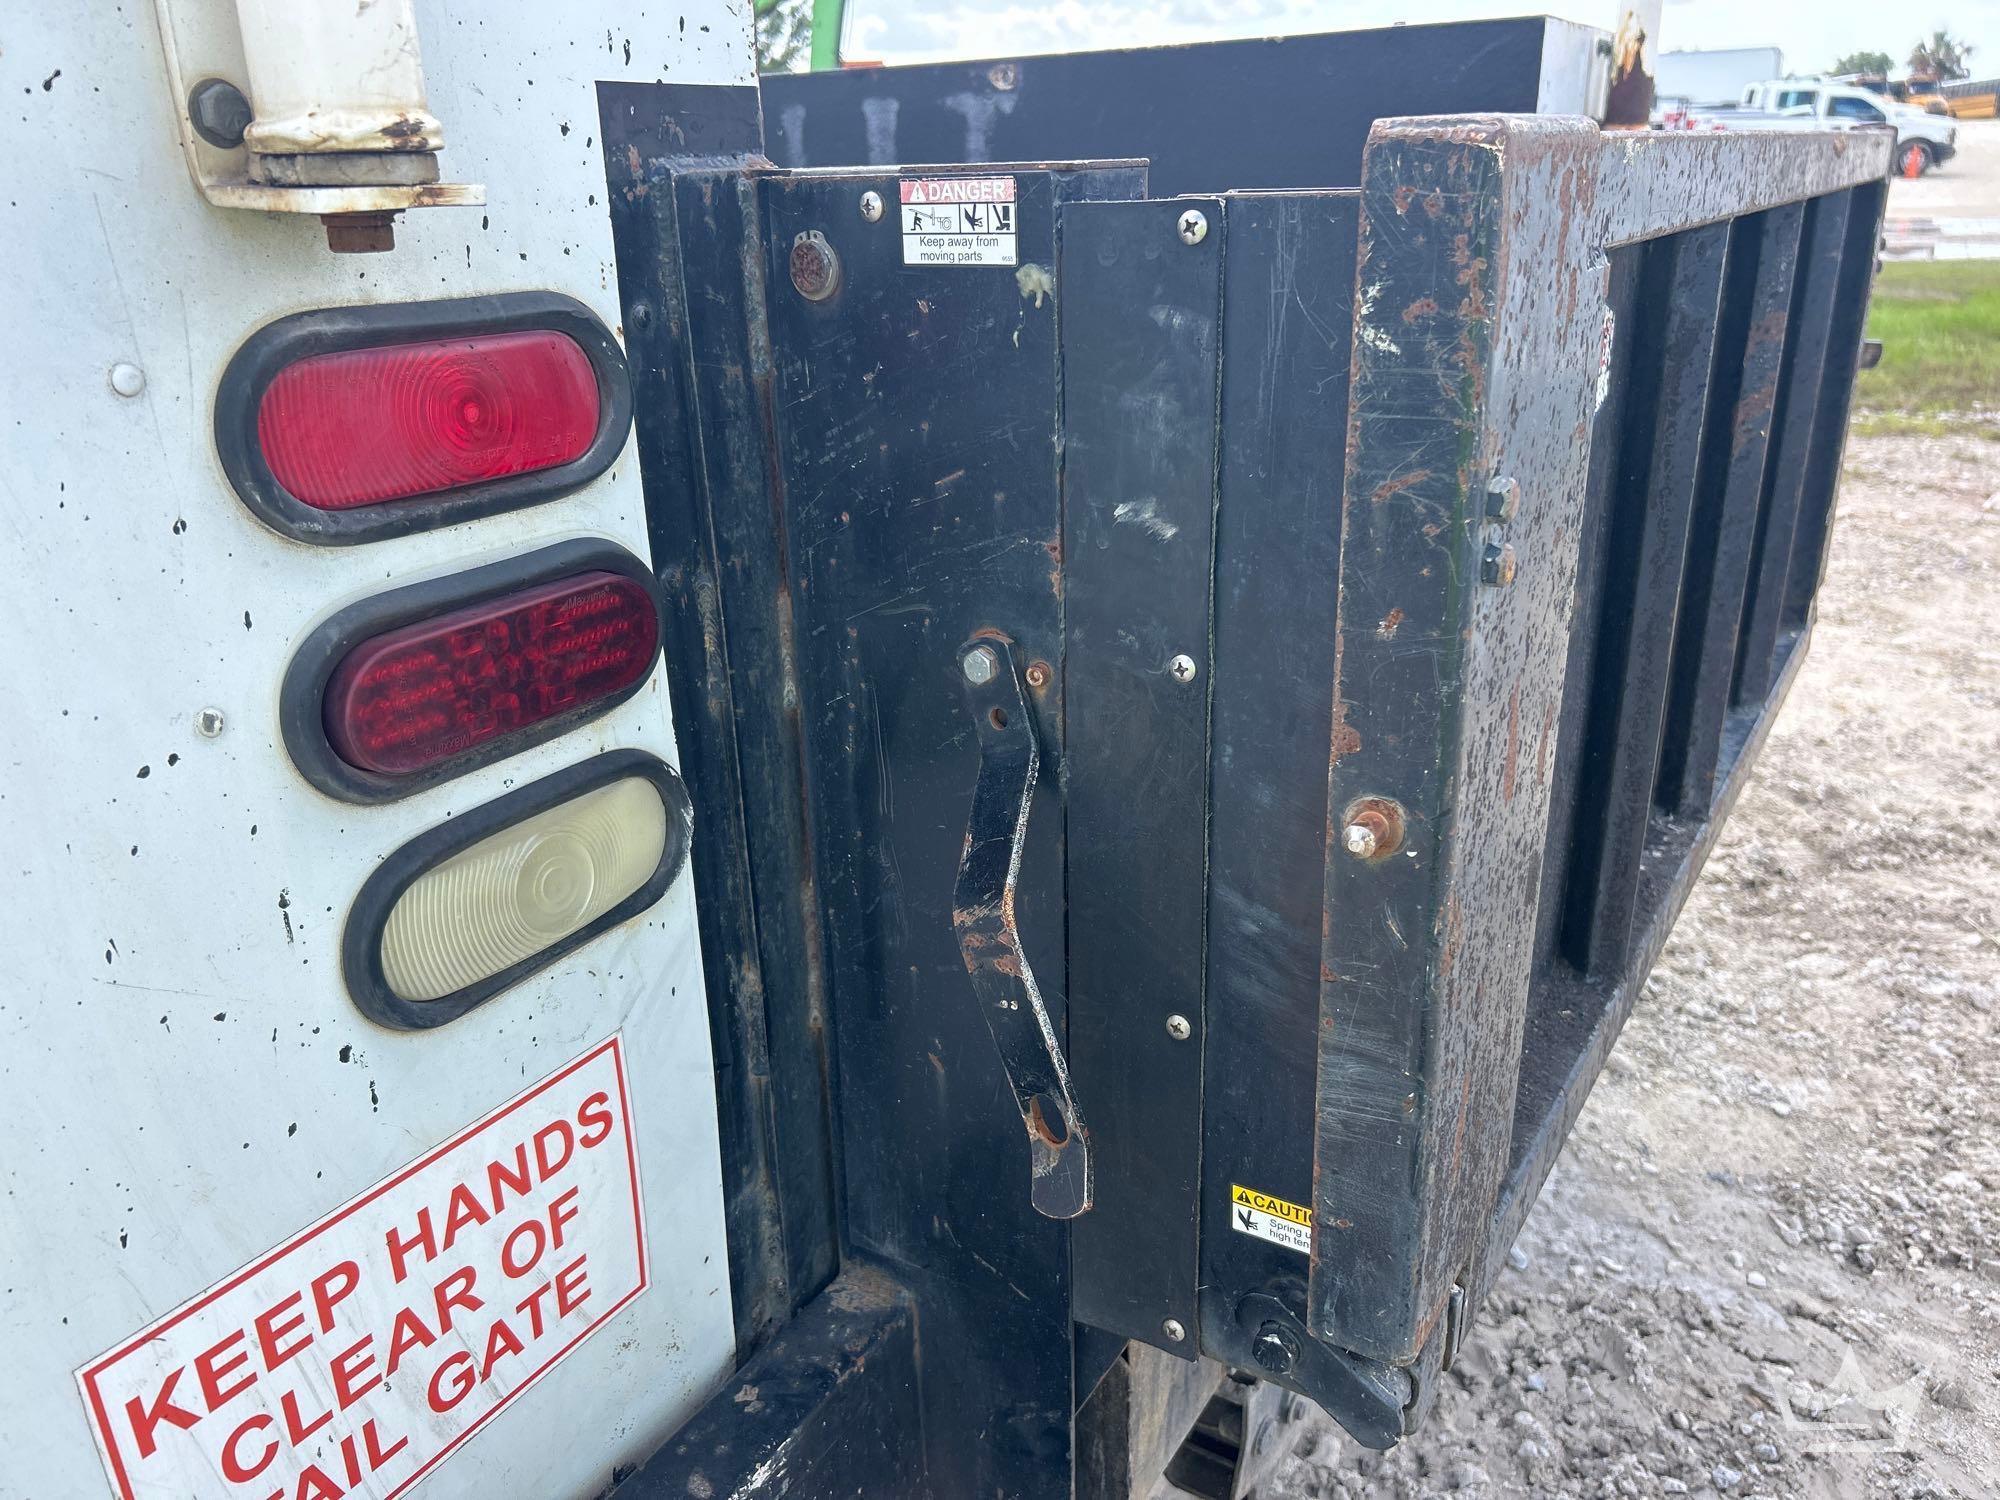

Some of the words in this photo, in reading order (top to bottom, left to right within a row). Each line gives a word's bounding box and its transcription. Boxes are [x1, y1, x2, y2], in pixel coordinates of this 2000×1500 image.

[928, 181, 1005, 201] DANGER
[919, 236, 945, 250] Keep
[947, 239, 974, 250] away
[976, 235, 999, 247] from
[920, 251, 955, 263] moving
[957, 251, 983, 263] parts
[1269, 1219, 1302, 1237] Spring
[1269, 1229, 1291, 1241] high
[1293, 1237, 1311, 1248] ten
[126, 1262, 359, 1457] KEEP
[387, 1093, 613, 1283] HANDS
[222, 1268, 482, 1483] CLEAR
[502, 1188, 579, 1279] OF
[262, 1421, 407, 1500] AIL
[428, 1256, 590, 1413] GATE
